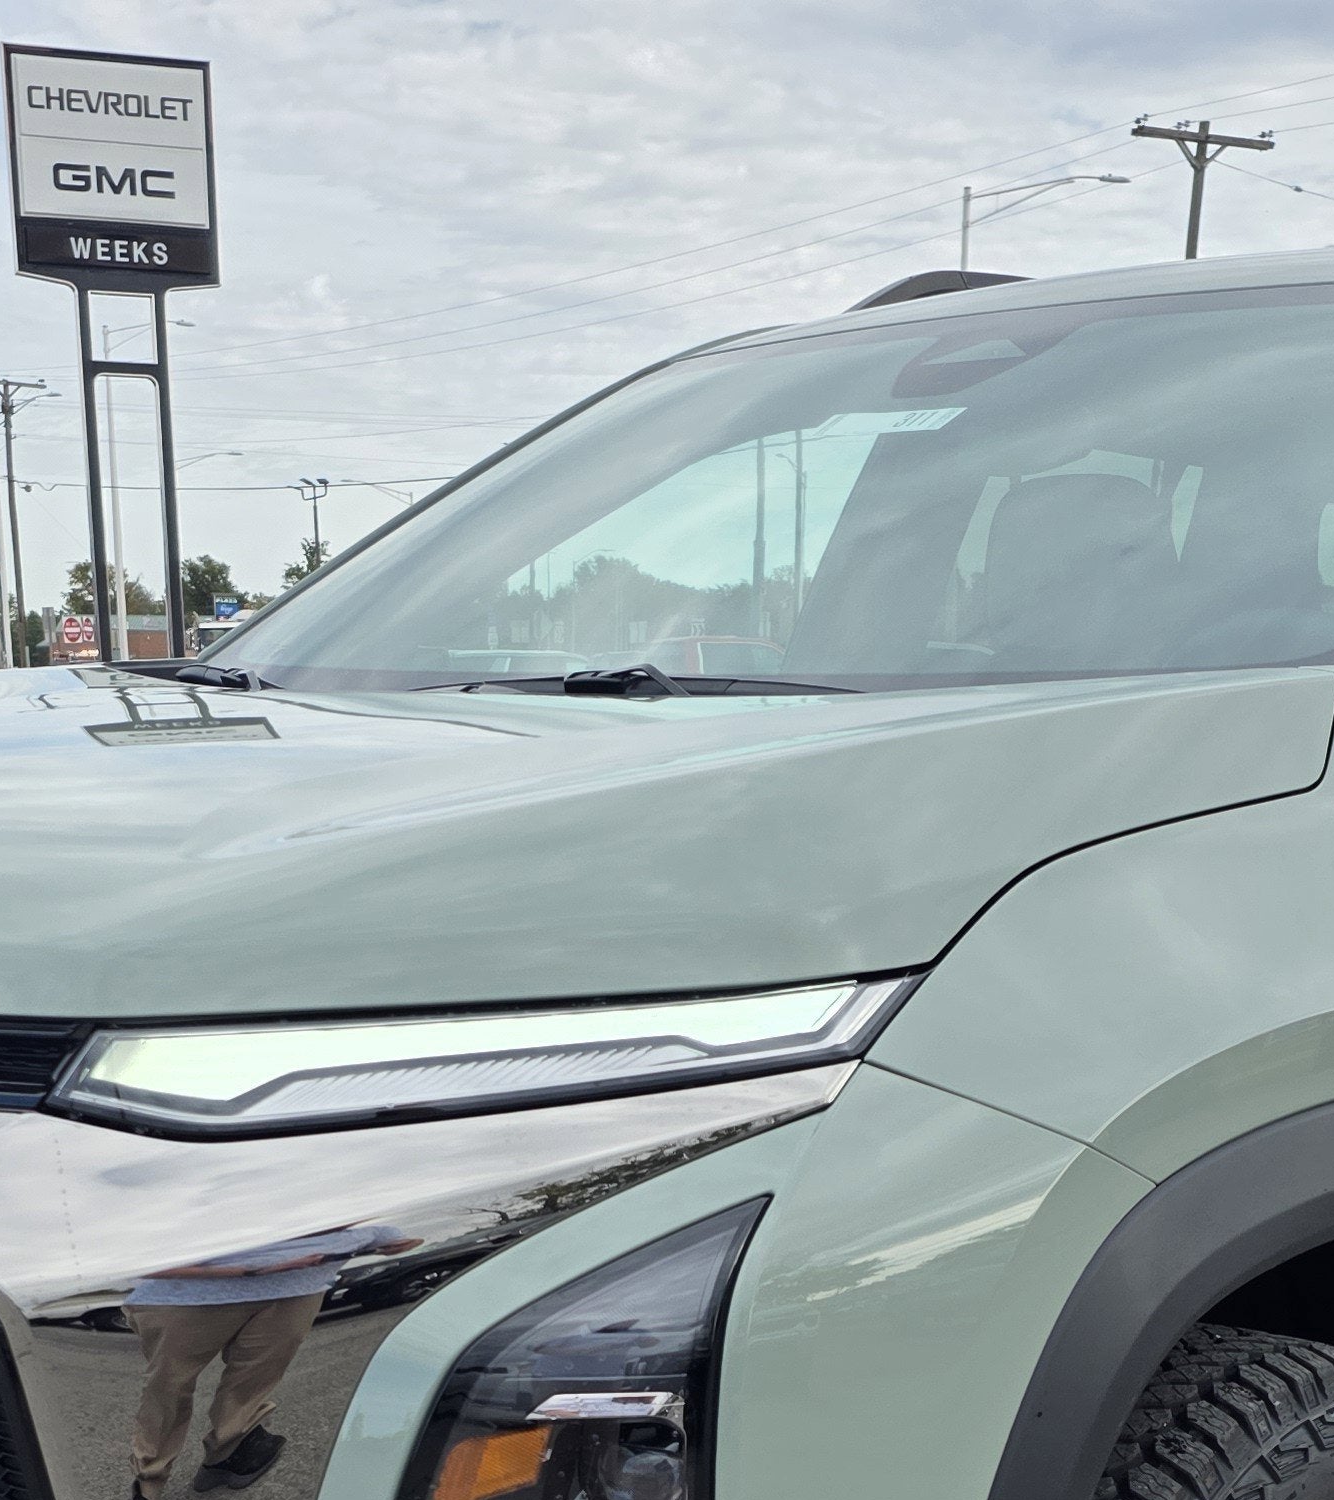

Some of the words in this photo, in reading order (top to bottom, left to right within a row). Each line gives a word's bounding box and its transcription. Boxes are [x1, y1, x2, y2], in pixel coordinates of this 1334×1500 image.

[27, 85, 193, 121] CHEVROLET
[53, 163, 175, 199] GMC
[70, 236, 169, 265] WEEKS
